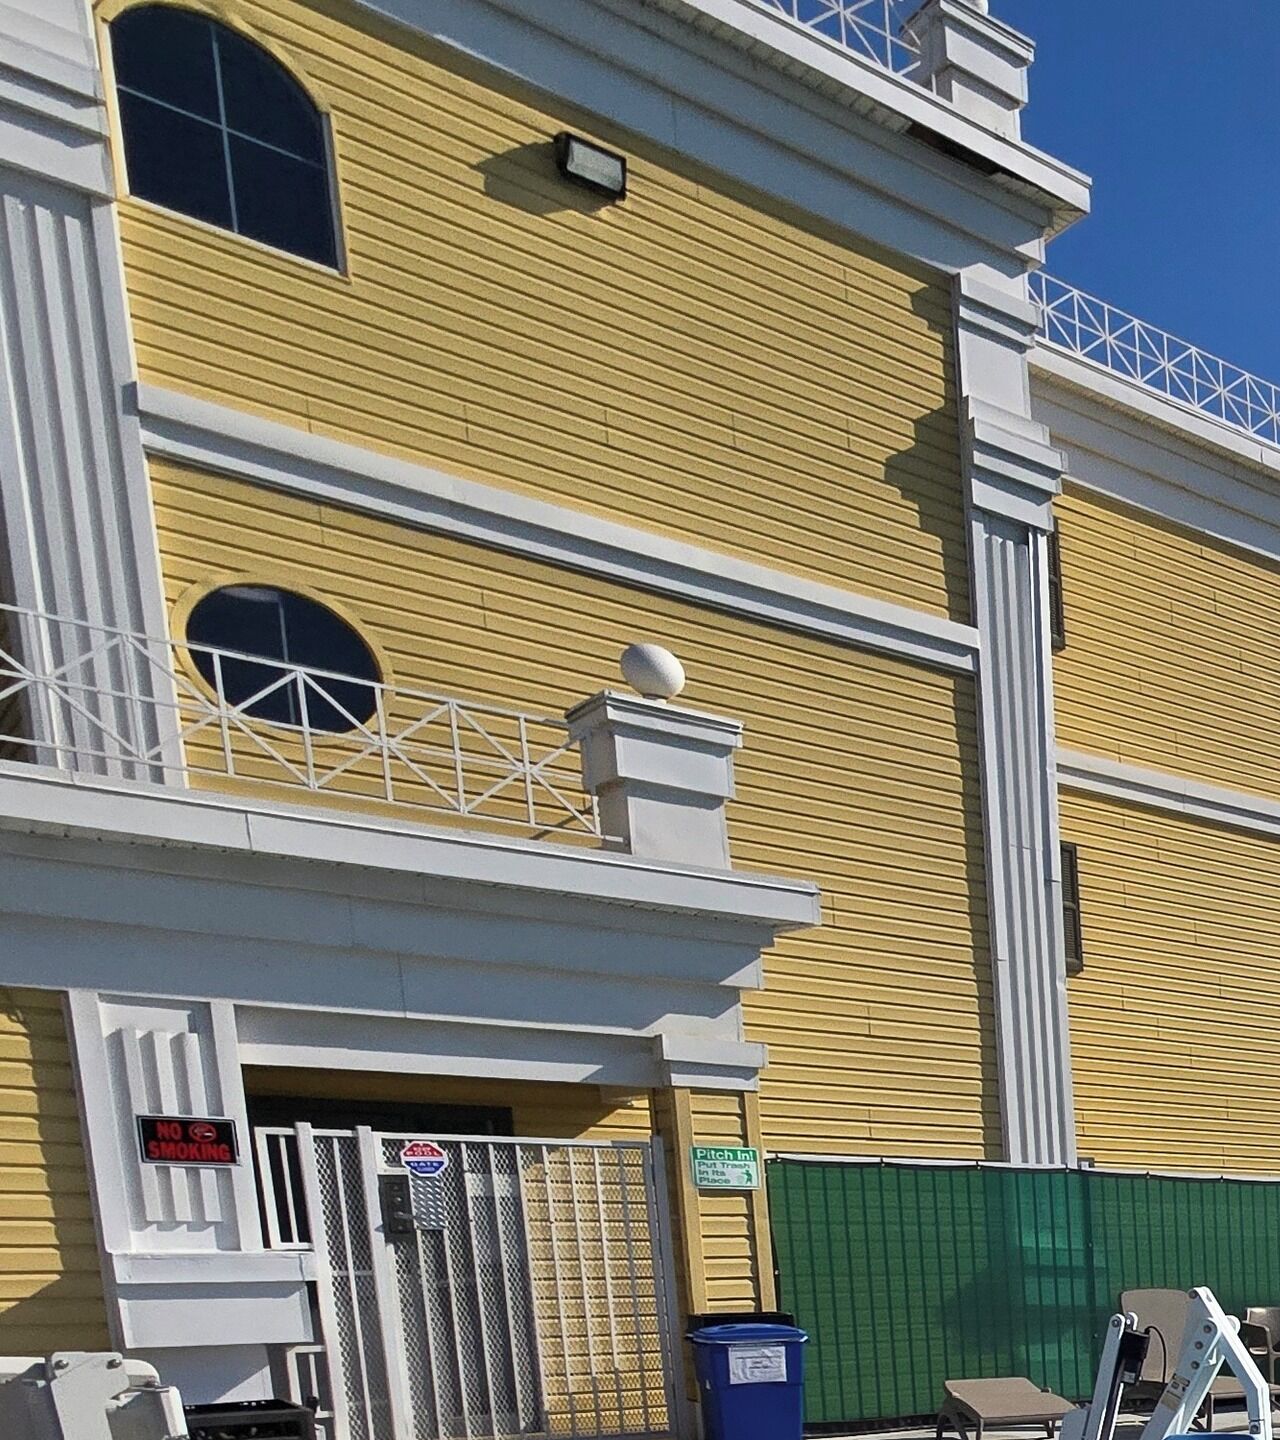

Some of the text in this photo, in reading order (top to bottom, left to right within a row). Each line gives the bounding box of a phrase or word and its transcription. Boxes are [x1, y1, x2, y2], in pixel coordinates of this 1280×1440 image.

[156, 1121, 182, 1140] NO
[148, 1140, 231, 1161] SMOKING
[696, 1148, 754, 1161] Pitch In!
[699, 1176, 731, 1184] Place
